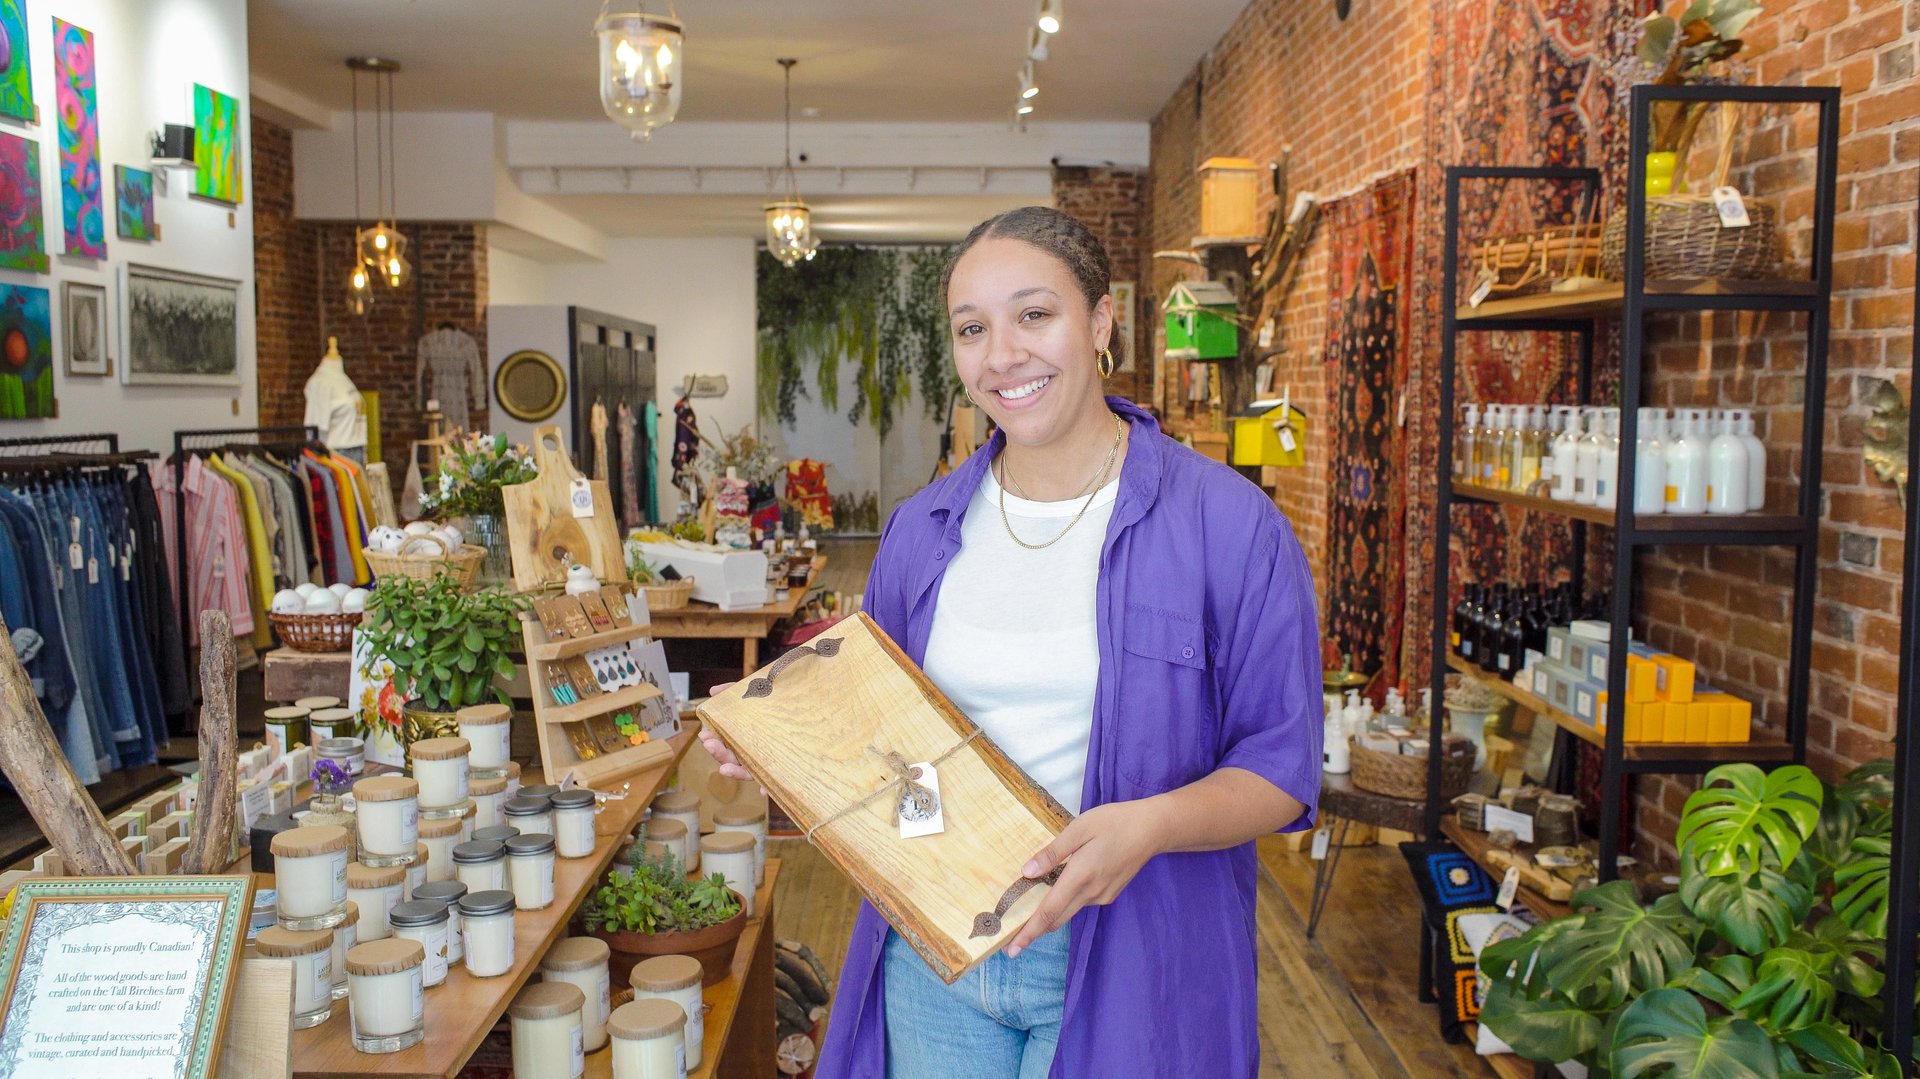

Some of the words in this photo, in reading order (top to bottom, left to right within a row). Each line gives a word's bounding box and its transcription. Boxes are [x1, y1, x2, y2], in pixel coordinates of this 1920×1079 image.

[61, 943, 80, 954] This
[82, 943, 101, 956] shop
[103, 943, 112, 953] is
[112, 941, 148, 956] proudly
[149, 941, 195, 952] Canadian!
[54, 972, 68, 983] All
[69, 972, 80, 982] of
[80, 972, 92, 982] the
[94, 972, 120, 982] wood
[118, 970, 148, 984] goods
[150, 972, 164, 980] are
[166, 970, 188, 980] hand
[48, 986, 79, 998] crafted
[92, 986, 108, 996] the
[111, 986, 127, 996] Tall
[129, 986, 164, 996] Birches
[165, 986, 185, 996] farm
[66, 1002, 82, 1012] and
[82, 1004, 97, 1012] are
[98, 1004, 115, 1012] one
[117, 1000, 128, 1012] of
[128, 1003, 134, 1012] a
[136, 1000, 162, 1011] kind!
[34, 1032, 53, 1043] The
[54, 1032, 90, 1044] clothing
[91, 1032, 110, 1042] and
[110, 1031, 163, 1042] accessories
[164, 1032, 178, 1041] are
[65, 1047, 100, 1058] curated
[100, 1046, 118, 1057] and
